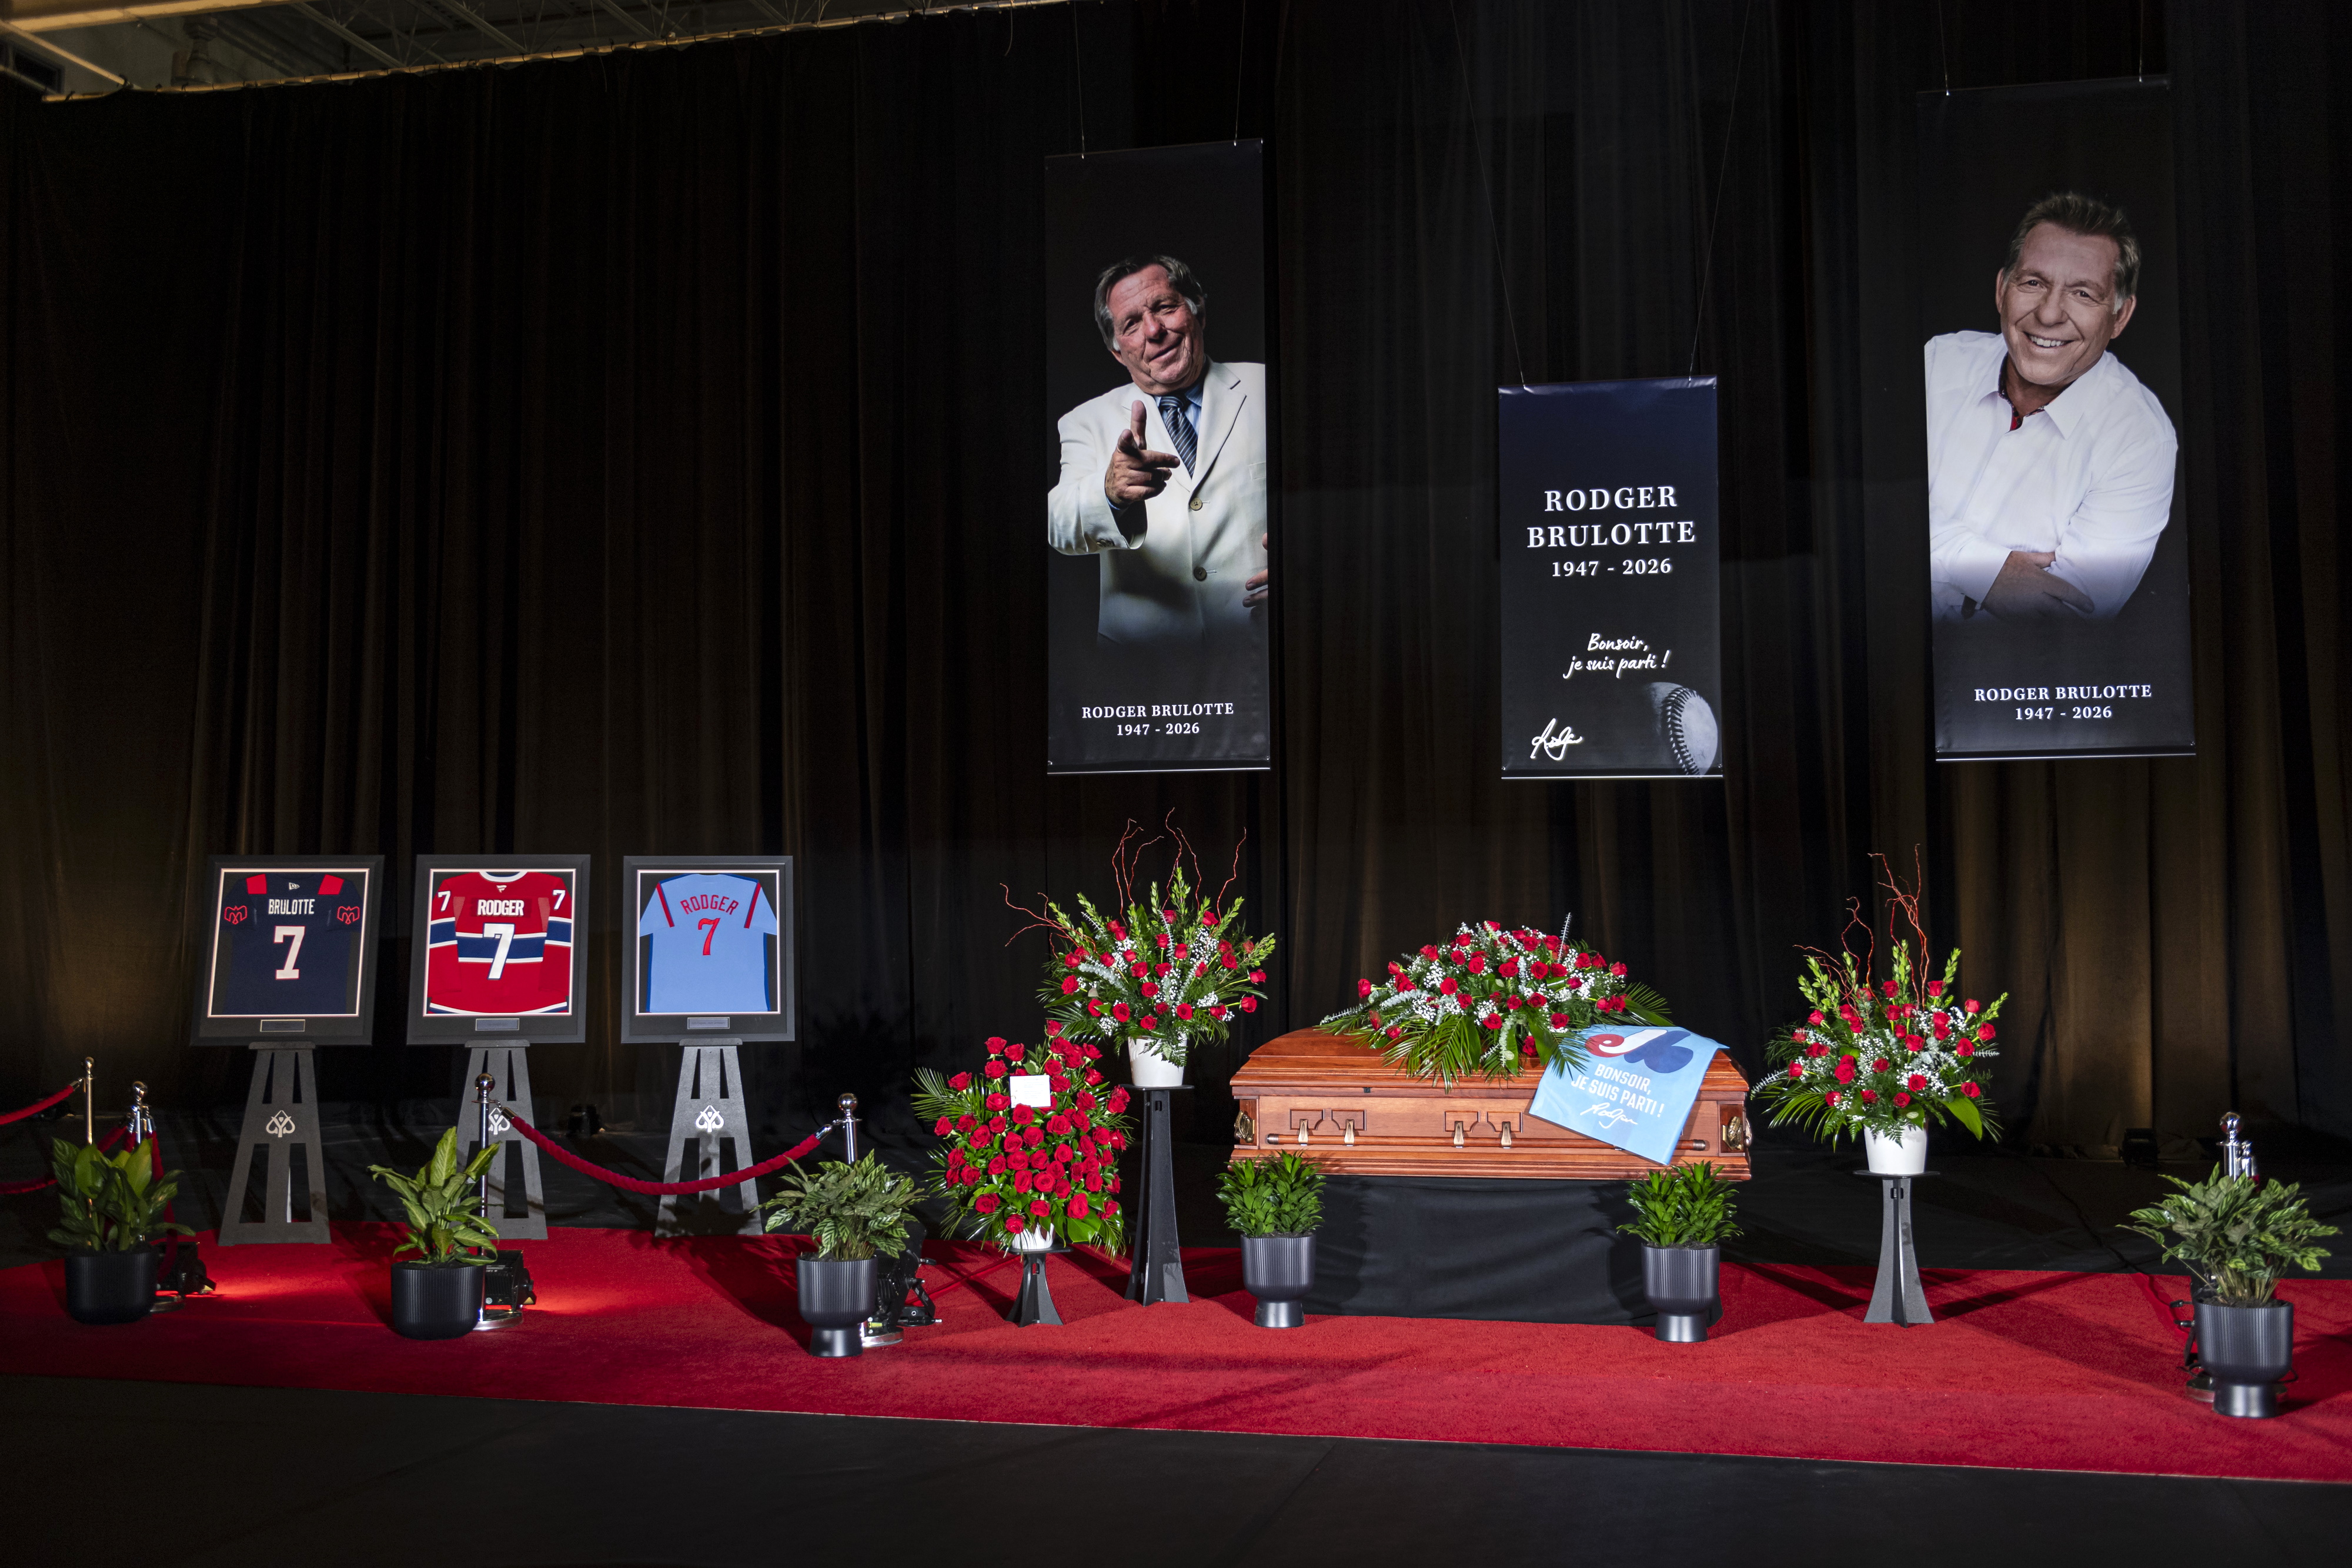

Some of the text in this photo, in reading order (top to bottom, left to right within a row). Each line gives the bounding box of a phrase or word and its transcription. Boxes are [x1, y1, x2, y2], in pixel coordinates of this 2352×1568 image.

[1545, 486, 1677, 511] RODGER
[1527, 521, 1695, 547] BRULOTTE
[1552, 561, 1598, 576] 1947
[1623, 559, 1672, 574] 2026
[1587, 633, 1648, 651] Bonsoir,
[1563, 650, 1671, 678] je suis parti !
[1975, 685, 2151, 701] RODGER BRULOTTE
[1082, 703, 1234, 718] RODGER BRULOTTE
[2016, 708, 2053, 720] 1947
[2073, 706, 2112, 718] 2026
[1117, 724, 1150, 735] 1947
[1166, 723, 1199, 734] 2026
[268, 898, 315, 914] BRULOTTE
[437, 891, 451, 911] 7
[477, 900, 524, 916] RODGER
[553, 890, 566, 910] 7
[680, 894, 739, 915] RODGER
[698, 917, 721, 955] 7
[273, 925, 305, 980] 7
[483, 923, 515, 979] 7
[1594, 1064, 1651, 1095] BONSOIR,
[1571, 1075, 1665, 1118] JE SUIS PARTI !
